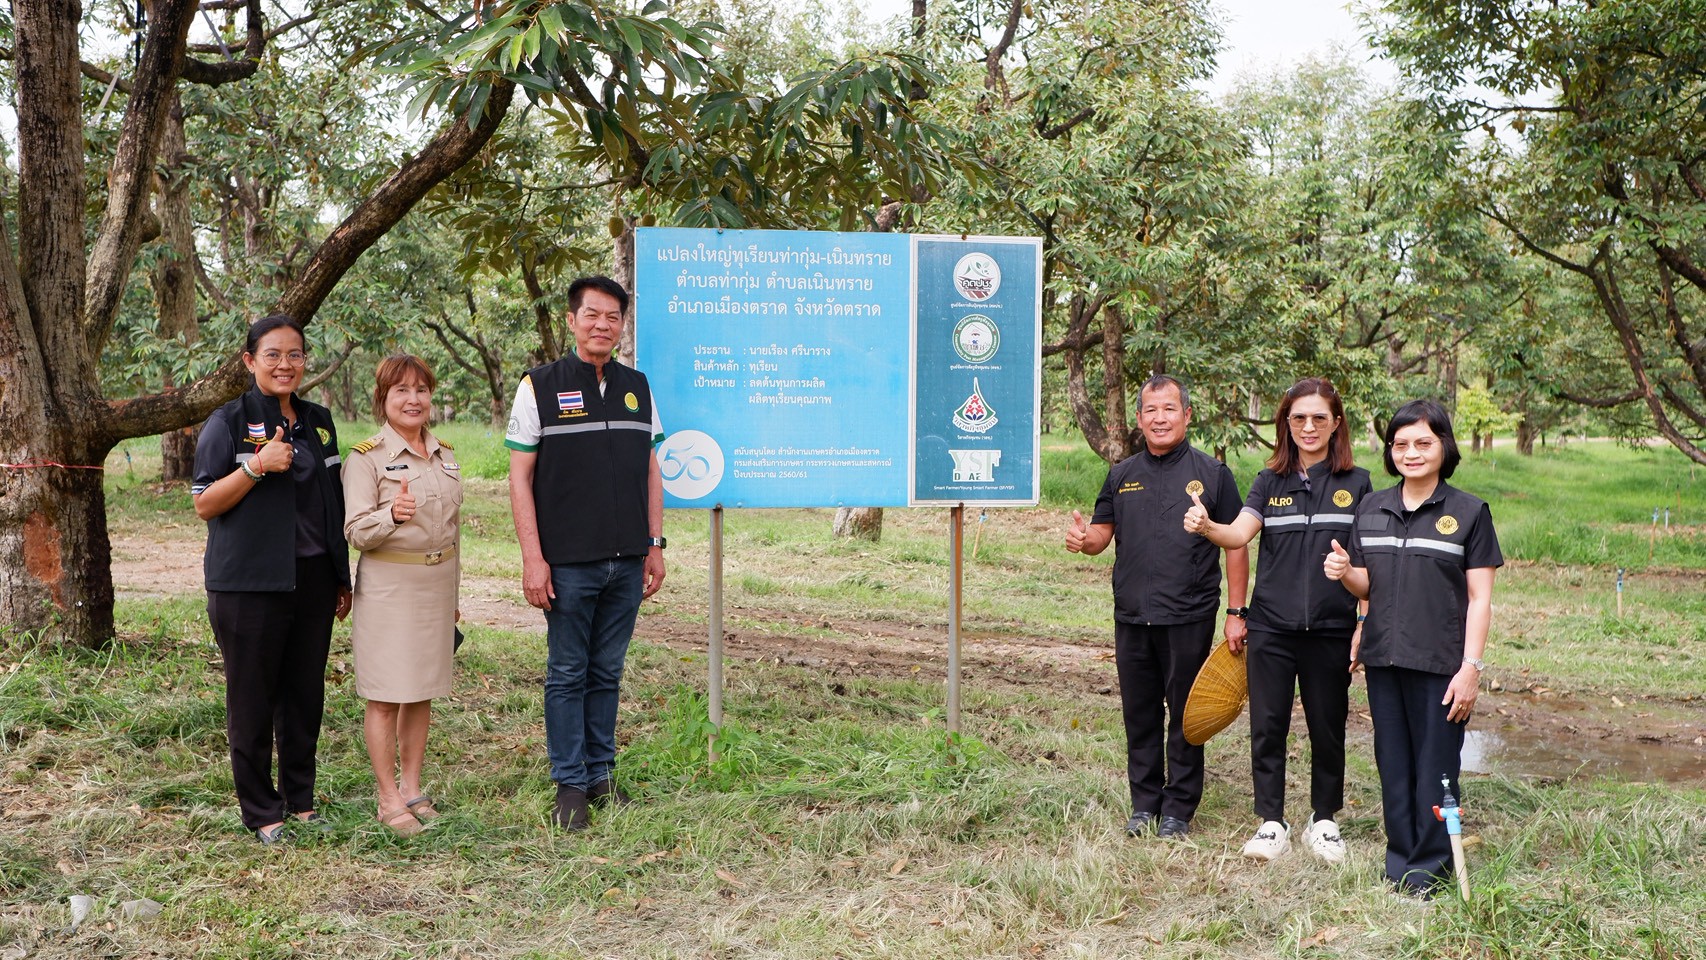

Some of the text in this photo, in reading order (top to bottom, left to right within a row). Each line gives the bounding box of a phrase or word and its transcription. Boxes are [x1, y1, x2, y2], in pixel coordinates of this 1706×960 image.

[657, 243, 892, 270] แปลงใหญ่ทุเรียนท่ากุ่ม-เนินทราย
[676, 269, 873, 294] ตำบลท่ากุ่ม ตำบลเนินทราย
[668, 295, 881, 316] อำเภอเมืองตราด จังหวัดตราด
[694, 345, 730, 355] ประธาน
[694, 359, 739, 371] สินค้าหลัก
[749, 359, 778, 374] ทุเรียน
[694, 375, 736, 388] เป้าหมาย
[749, 376, 826, 391] ลดต้นทุนการผลิต
[749, 392, 832, 407] ผลิตทุเรียนคุณภาพ
[779, 470, 808, 478] 2560/61
[1268, 497, 1293, 506] ALRO
